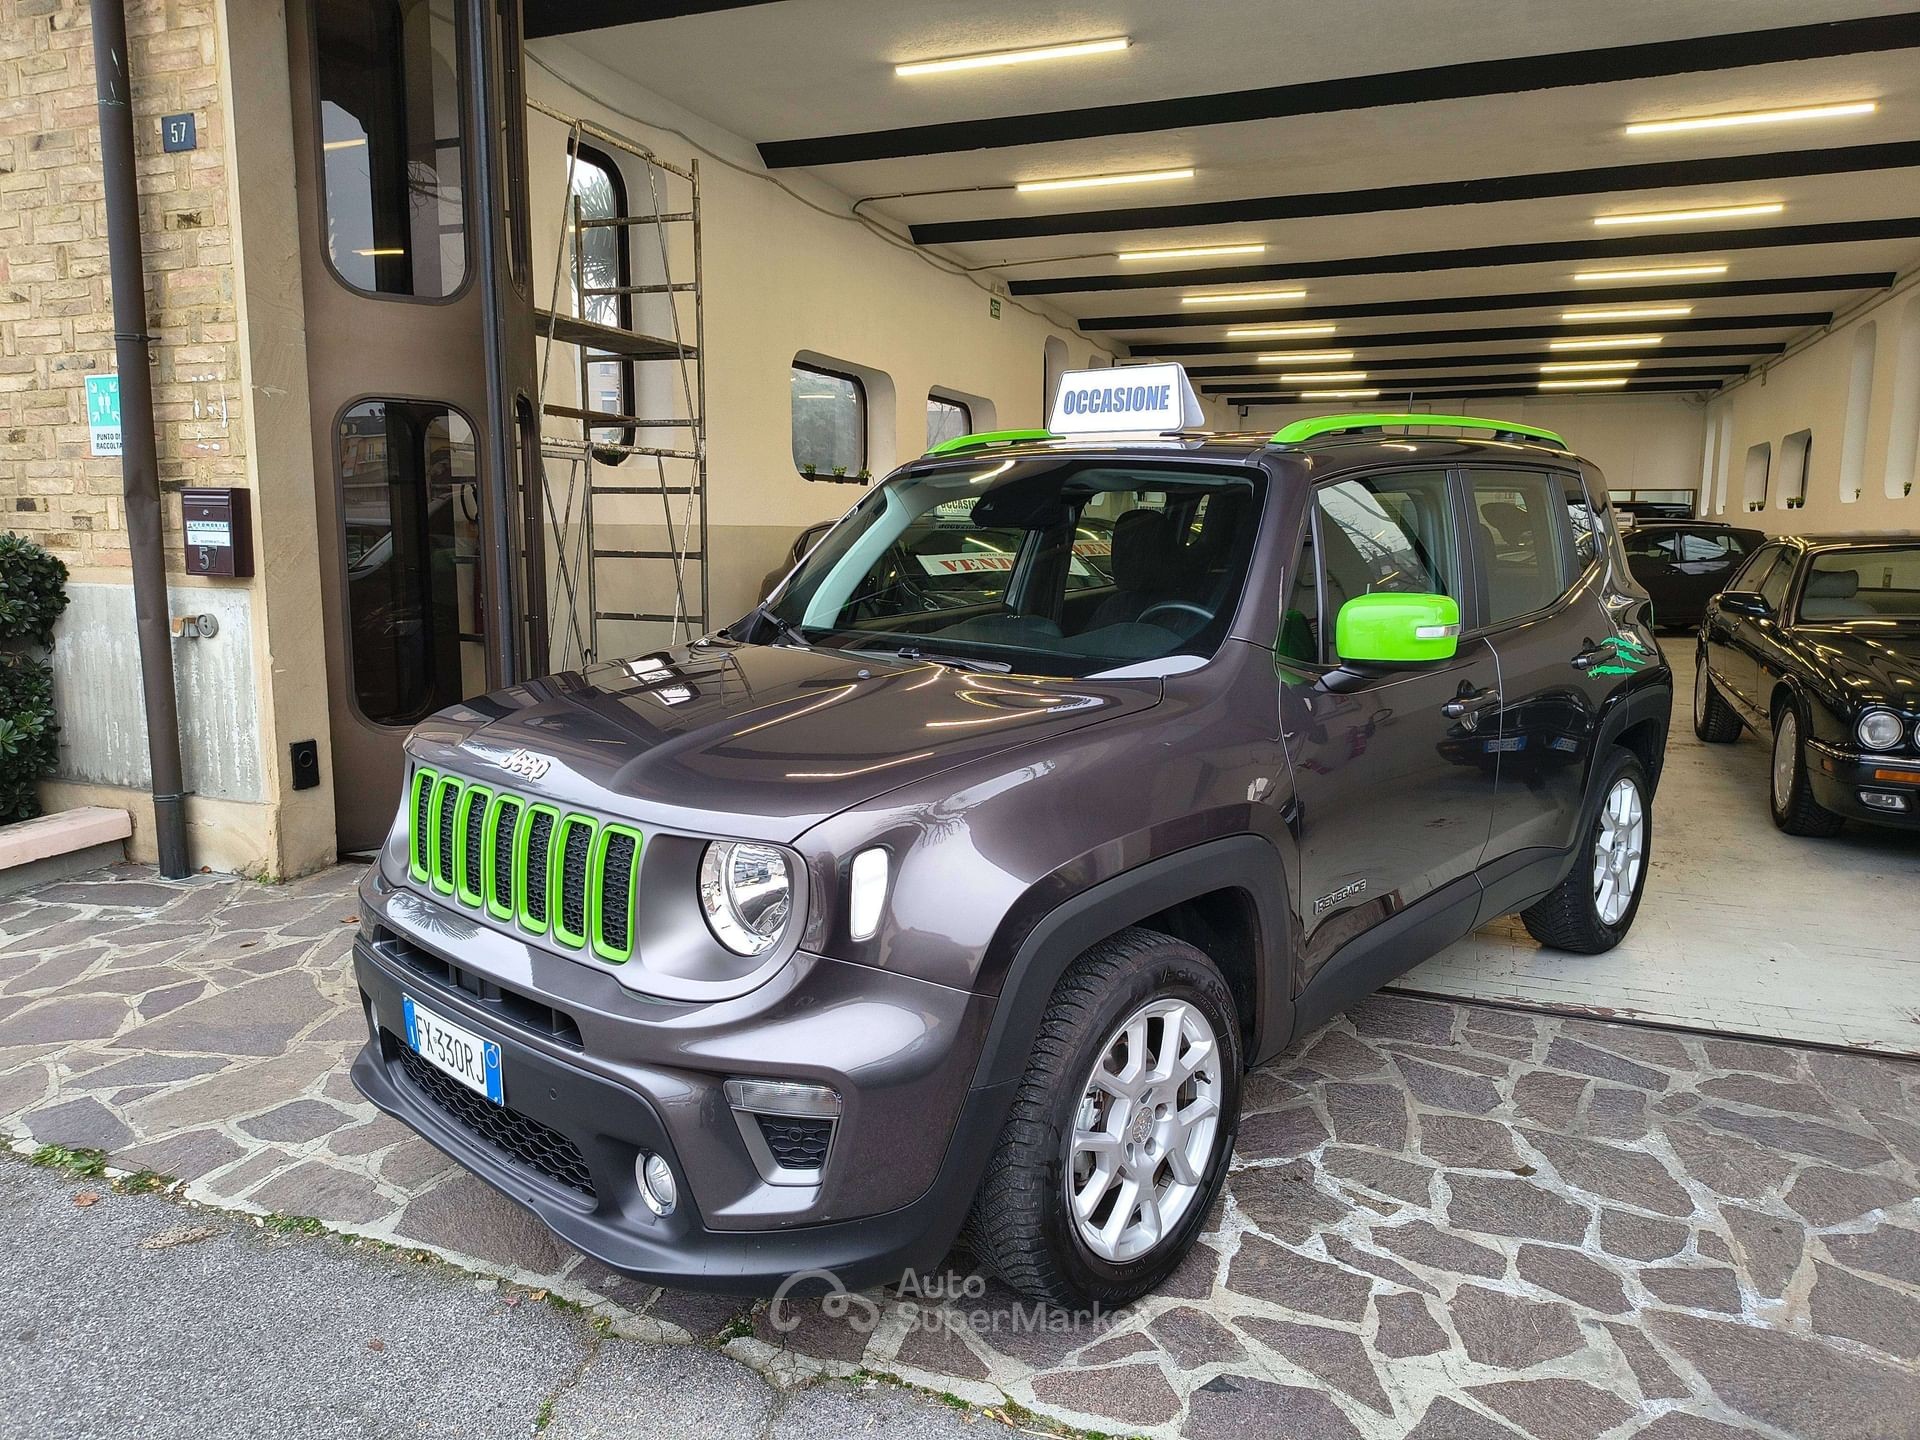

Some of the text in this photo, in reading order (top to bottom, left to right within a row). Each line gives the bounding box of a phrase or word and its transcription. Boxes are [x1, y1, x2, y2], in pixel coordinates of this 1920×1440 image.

[170, 121, 186, 143] 57
[1063, 384, 1171, 415] OCCASIONE
[199, 545, 218, 570] 57
[500, 748, 552, 783] Jeep
[1313, 878, 1367, 915] RENEGADE
